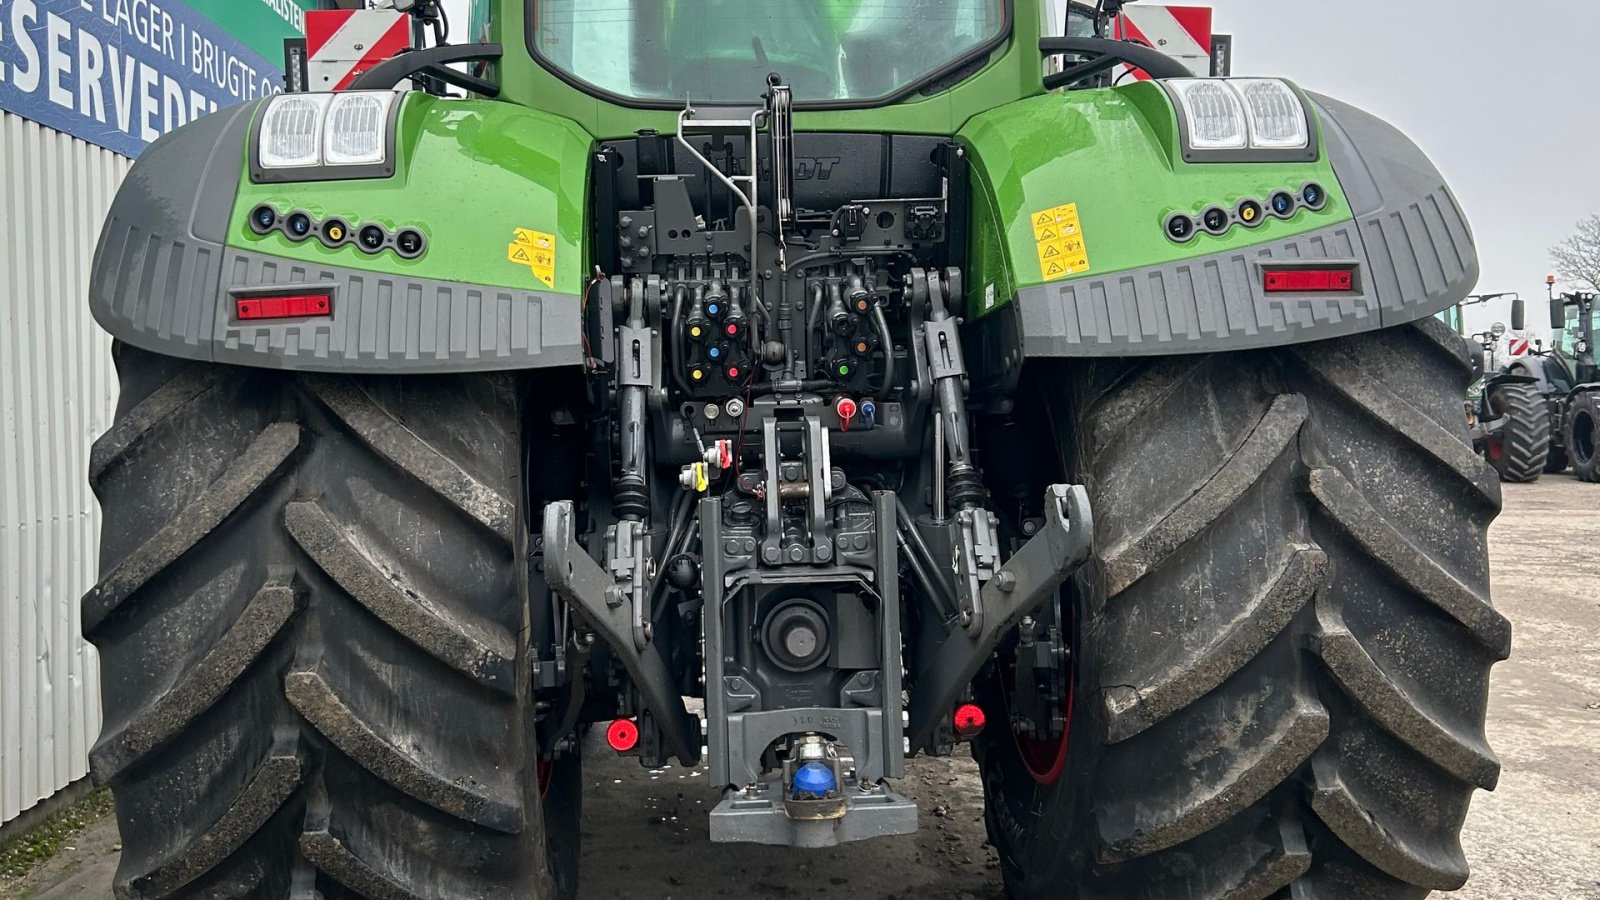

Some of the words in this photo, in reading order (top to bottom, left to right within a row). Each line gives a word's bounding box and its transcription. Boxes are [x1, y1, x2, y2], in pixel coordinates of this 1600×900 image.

[262, 0, 305, 35] LISTEN
[0, 0, 218, 143] SERVED
[181, 24, 185, 66] I
[192, 30, 256, 100] BRUGTE
